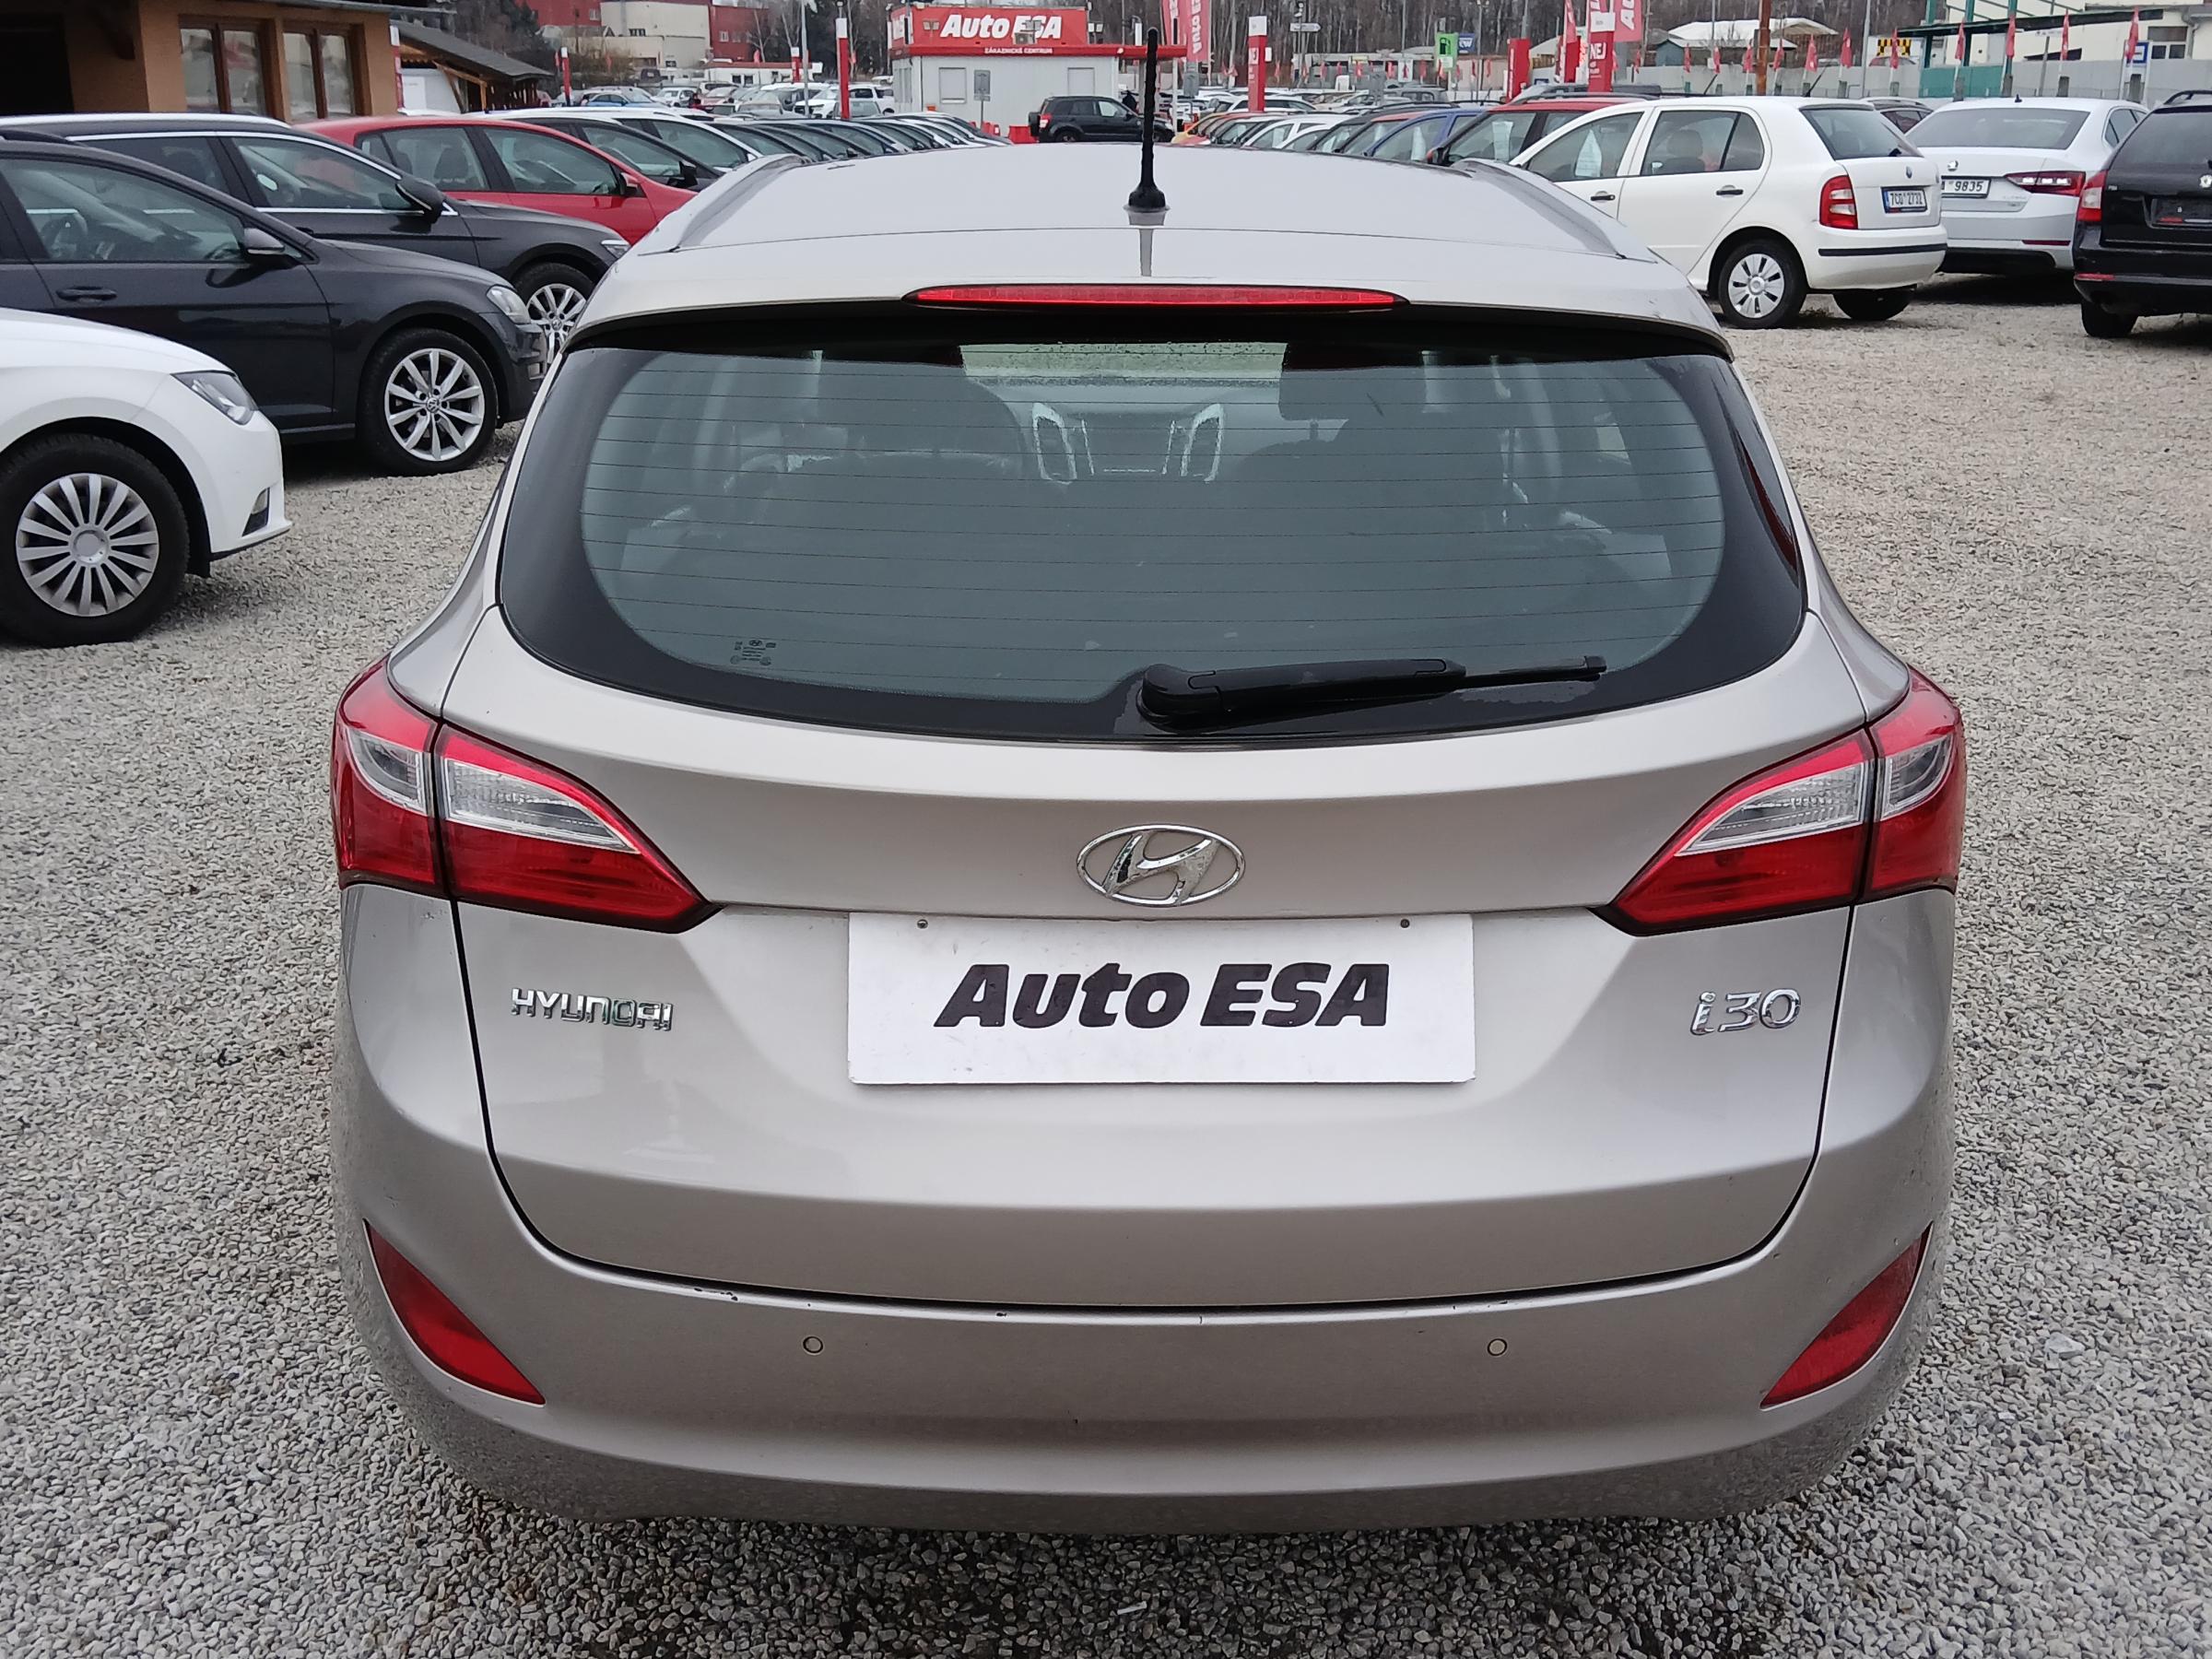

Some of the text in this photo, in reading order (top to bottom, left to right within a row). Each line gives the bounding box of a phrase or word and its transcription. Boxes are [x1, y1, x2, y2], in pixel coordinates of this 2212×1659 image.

[940, 14, 1010, 39] Auto
[1954, 181, 1984, 192] 9835
[512, 987, 674, 1031] HYUNDAI
[933, 961, 1390, 1030] Auto ESA
[1690, 988, 1801, 1036] i30
